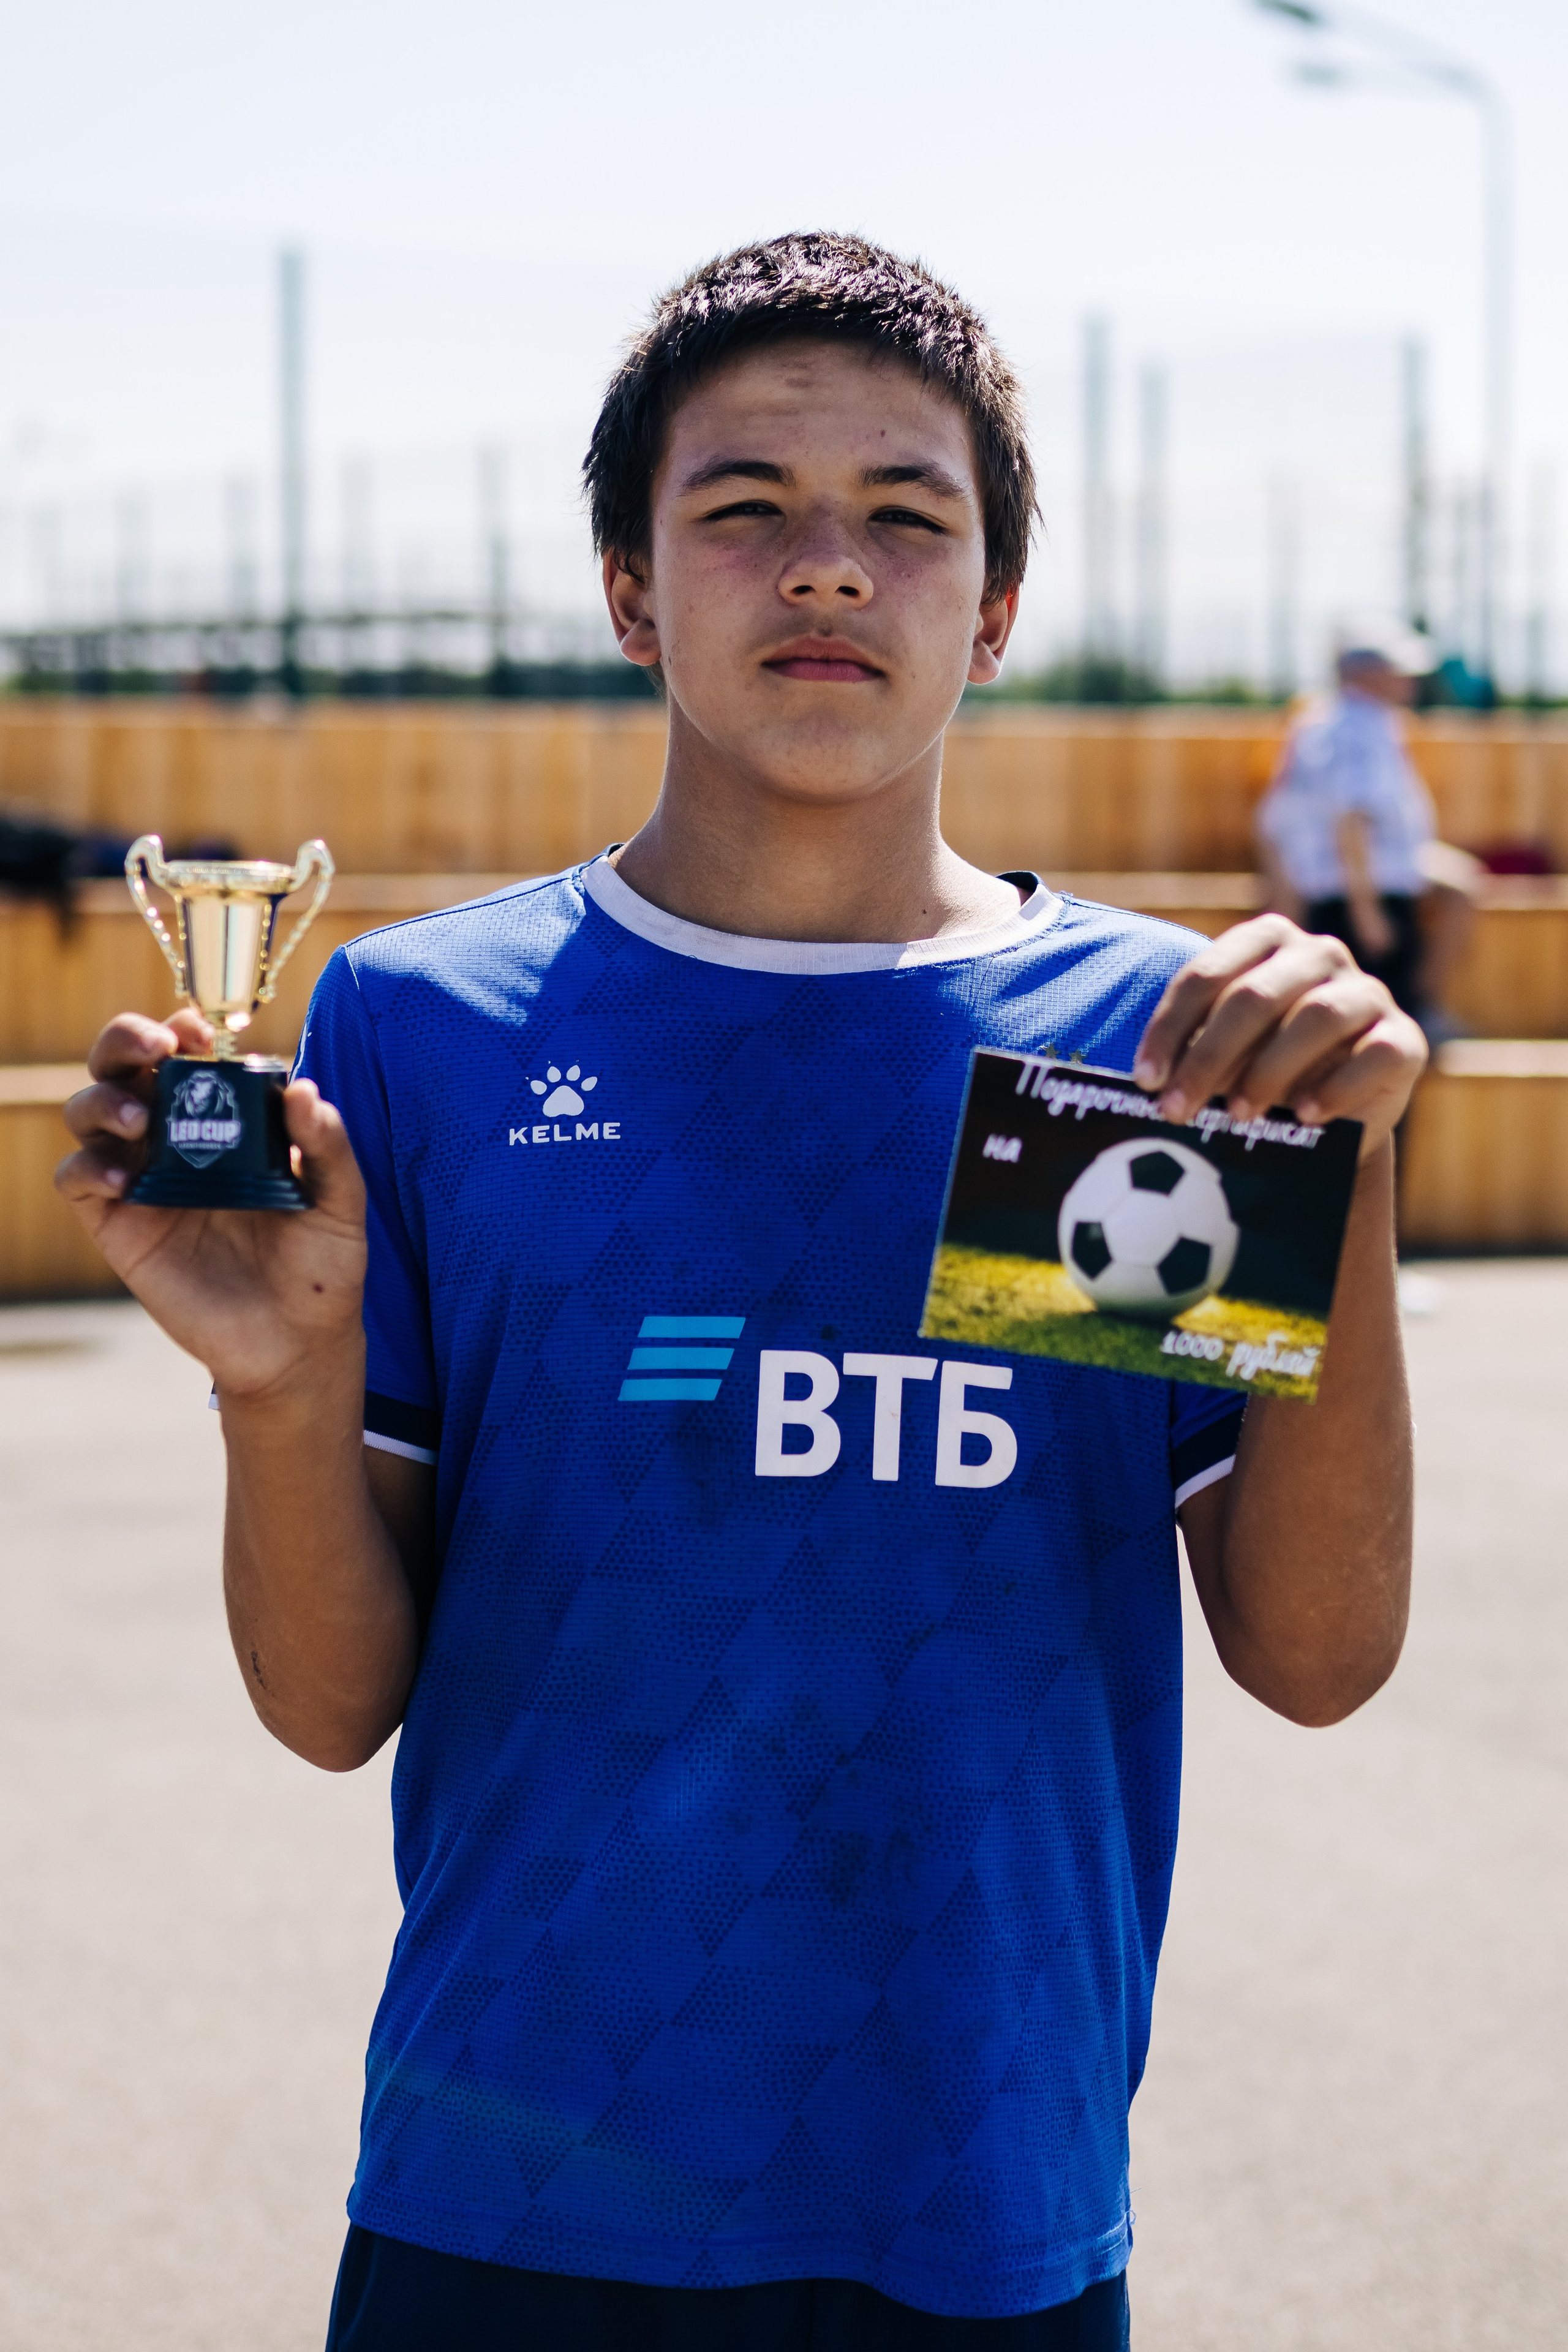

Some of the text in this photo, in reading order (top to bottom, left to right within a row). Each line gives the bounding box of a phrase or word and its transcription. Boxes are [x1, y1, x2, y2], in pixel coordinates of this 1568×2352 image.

[201, 1119, 241, 1142] CUP
[509, 1122, 621, 1146] KELME
[982, 1133, 1023, 1163] на
[1160, 1330, 1321, 1381] 1000 рублей
[755, 1350, 1017, 1488] ВТБ
